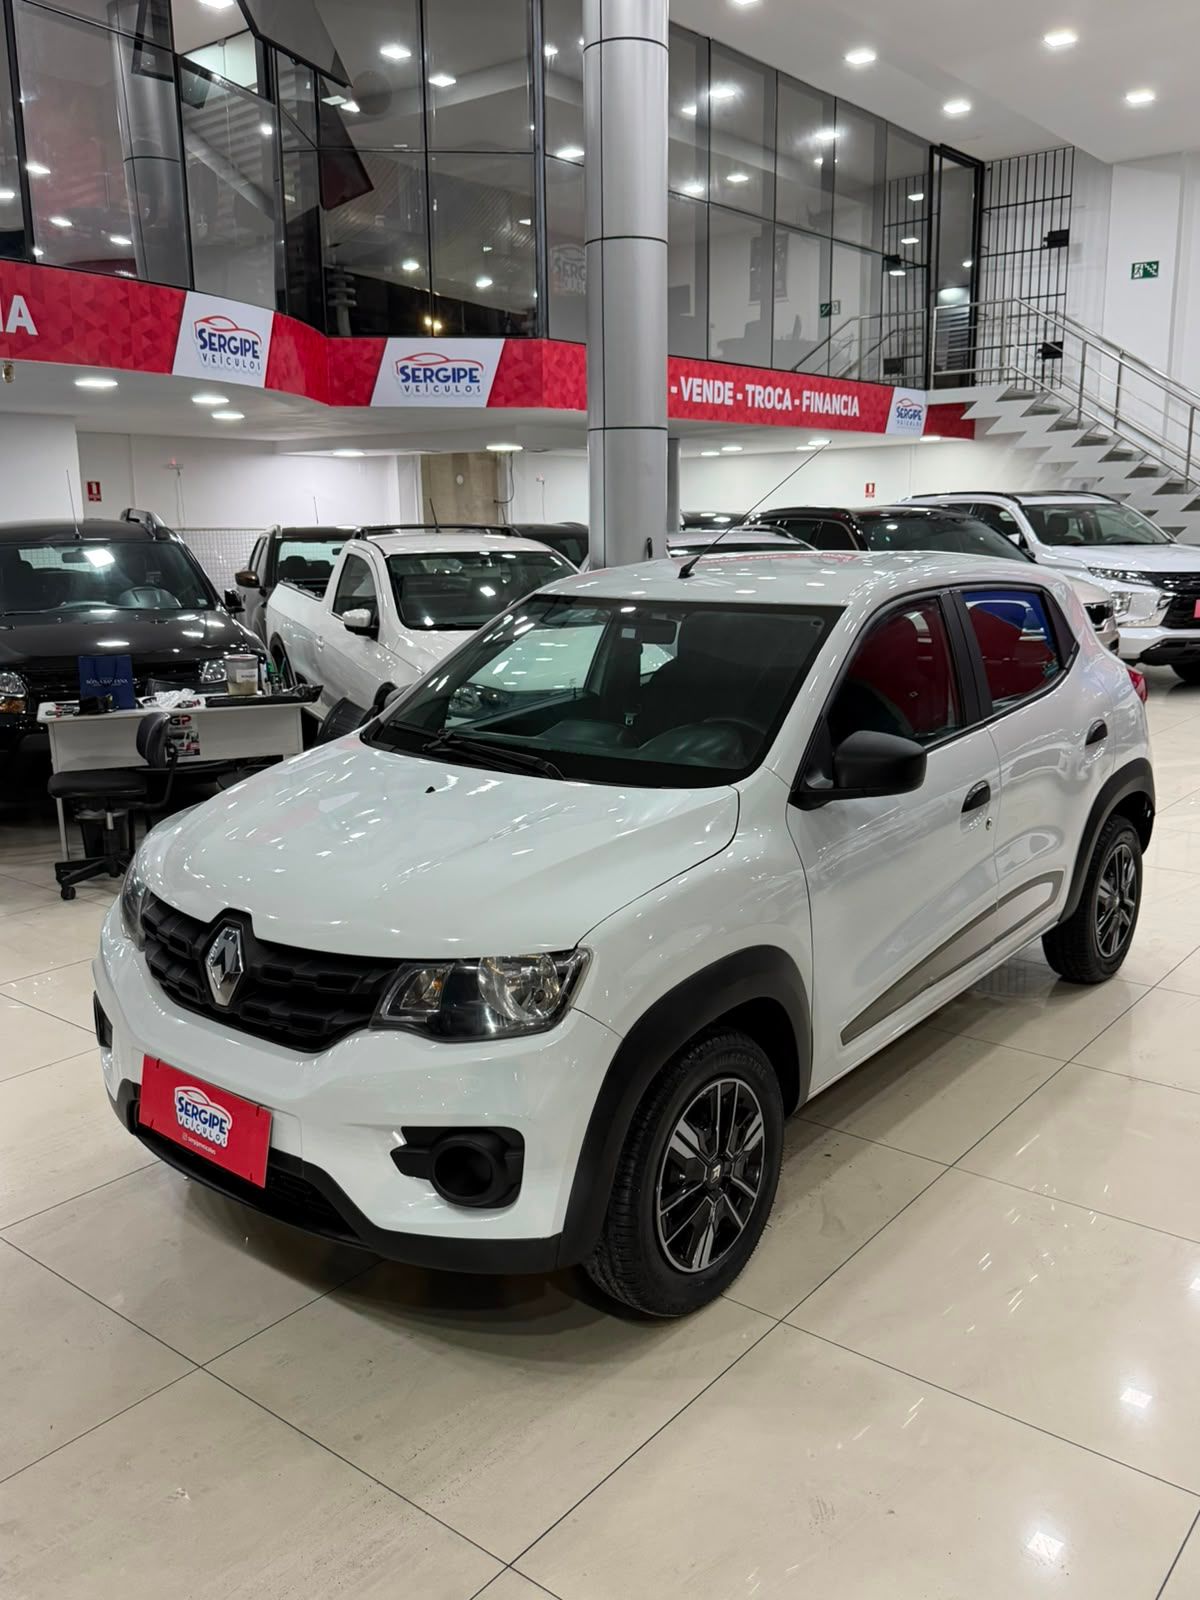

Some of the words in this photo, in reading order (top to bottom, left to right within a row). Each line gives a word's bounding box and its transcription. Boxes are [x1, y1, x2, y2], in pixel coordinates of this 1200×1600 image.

[198, 328, 260, 360] SERGIPE
[399, 365, 480, 383] SERGIPE
[680, 376, 733, 406] VENDE
[745, 383, 792, 411] TROCA
[802, 390, 860, 417] FINANCIA
[178, 1096, 227, 1135] SERGIPE
